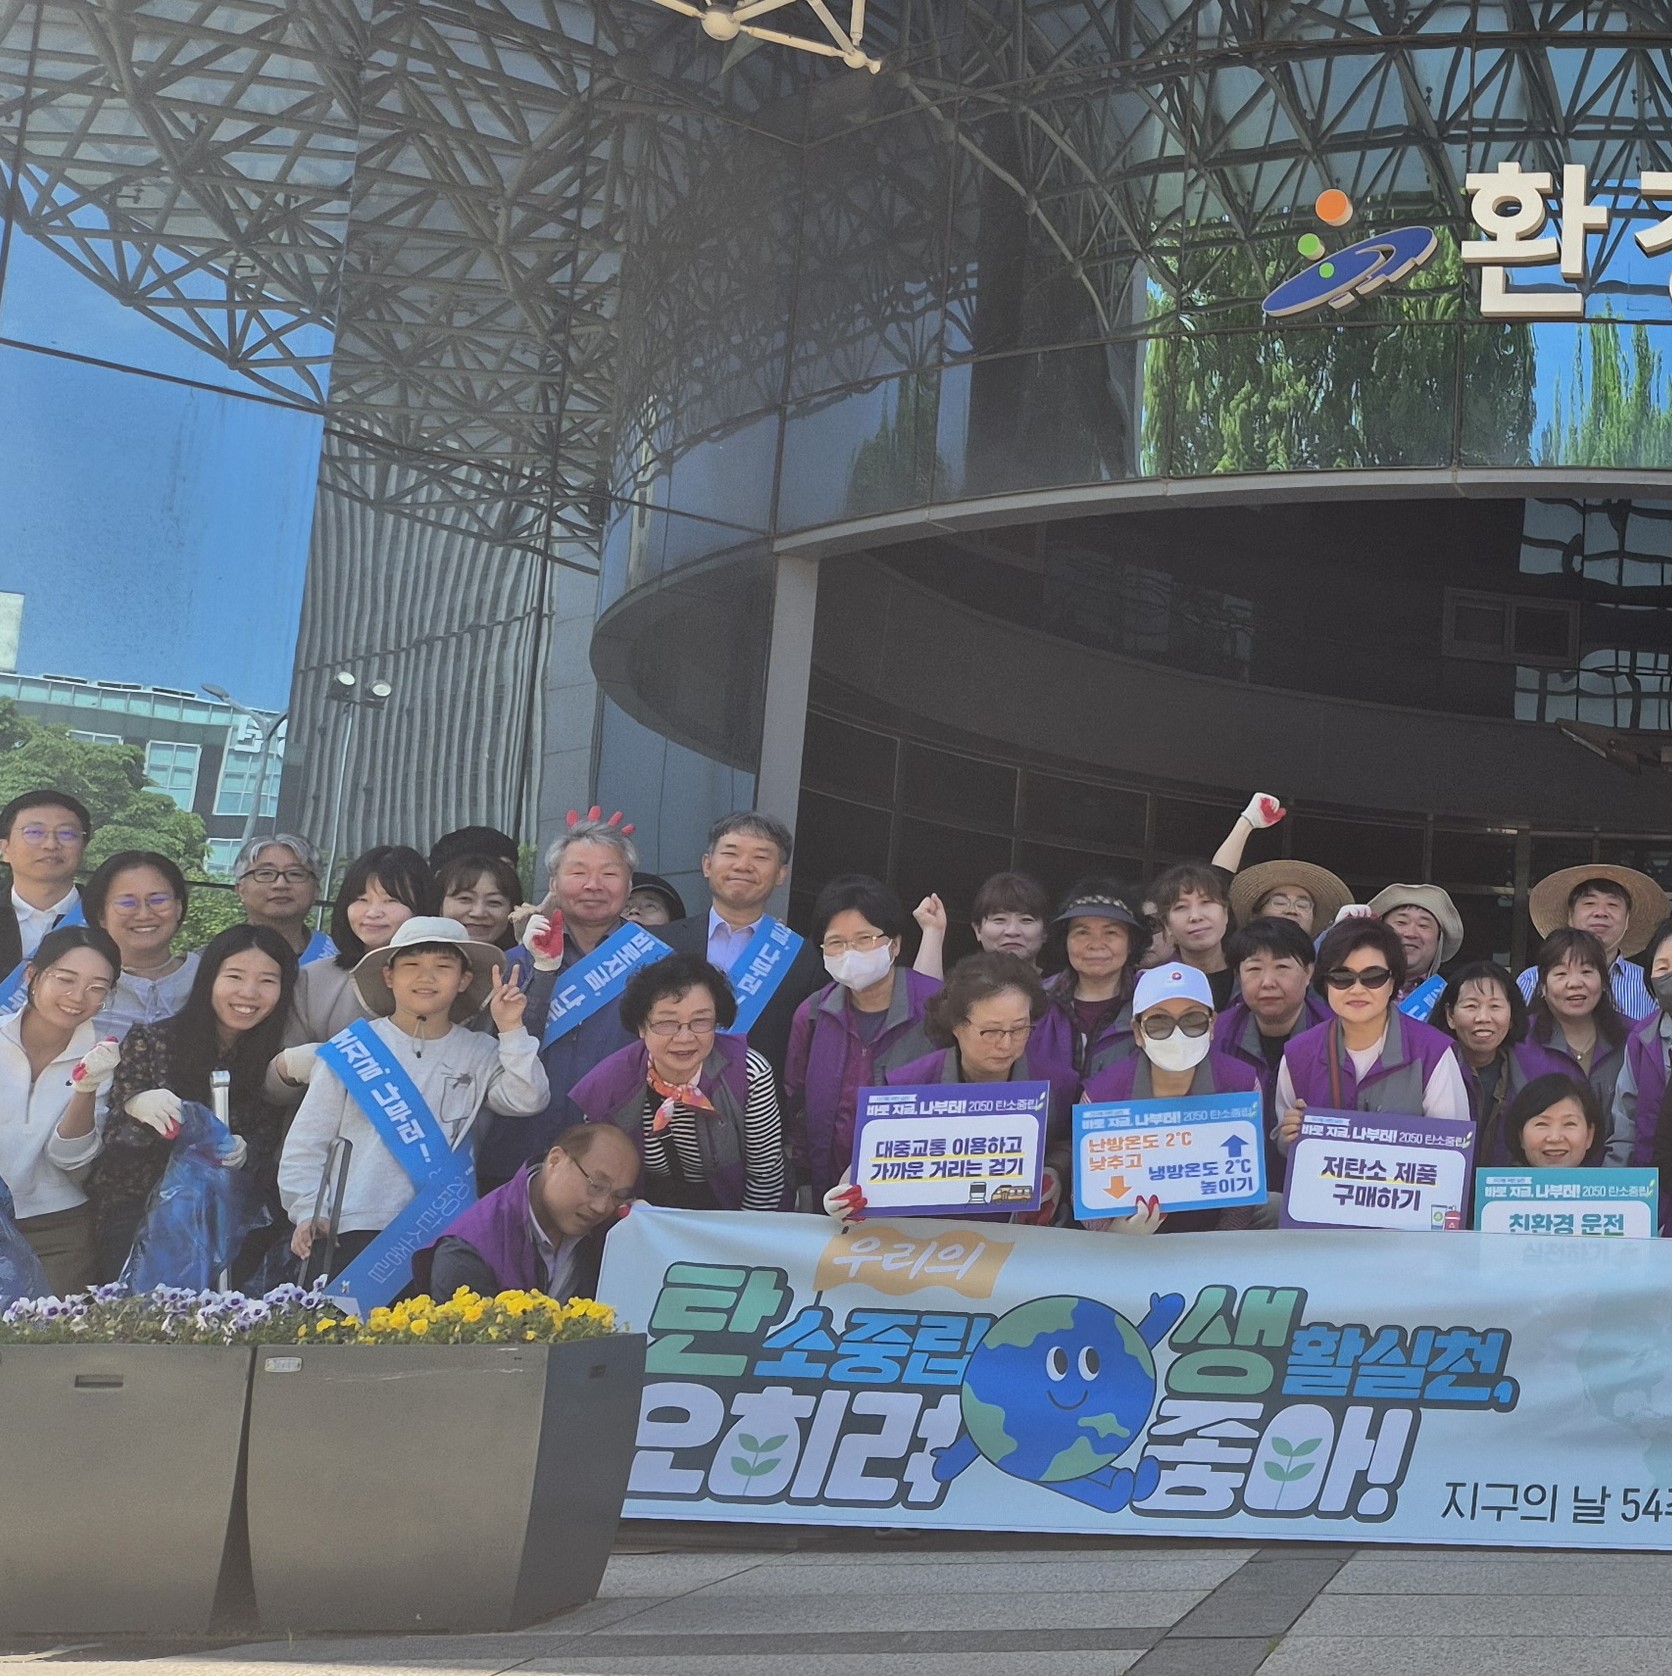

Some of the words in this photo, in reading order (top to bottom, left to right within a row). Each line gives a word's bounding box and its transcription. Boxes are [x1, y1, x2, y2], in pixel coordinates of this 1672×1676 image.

[968, 1102, 993, 1112] 2050
[1184, 1111, 1208, 1121] 2050
[875, 1139, 946, 1158] 대중교통
[953, 1137, 1022, 1155] 이용하고
[1088, 1134, 1159, 1153] 난방온도
[1399, 1132, 1423, 1144] 2050
[870, 1162, 924, 1181] 가까운
[929, 1160, 982, 1178] 거리는
[989, 1158, 1023, 1176] 걷기
[1089, 1154, 1143, 1171] 낮추고
[1149, 1162, 1219, 1181] 냉방온도
[1321, 1156, 1388, 1181] 저탄소
[1393, 1162, 1438, 1185] 제품
[1201, 1177, 1253, 1195] 높이기
[1582, 1186, 1606, 1198] 2050
[1333, 1184, 1421, 1211] 구매하기
[1509, 1214, 1574, 1235] 친환경
[1581, 1213, 1624, 1236] 운전
[832, 1235, 986, 1280] 우리의
[643, 1264, 994, 1386] 탄소중립
[1168, 1287, 1514, 1404] 생활실천,
[627, 1382, 962, 1503] 오히려
[1144, 1399, 1414, 1516] 좋아!
[1441, 1482, 1558, 1523] 지구의
[1572, 1485, 1612, 1524] 날
